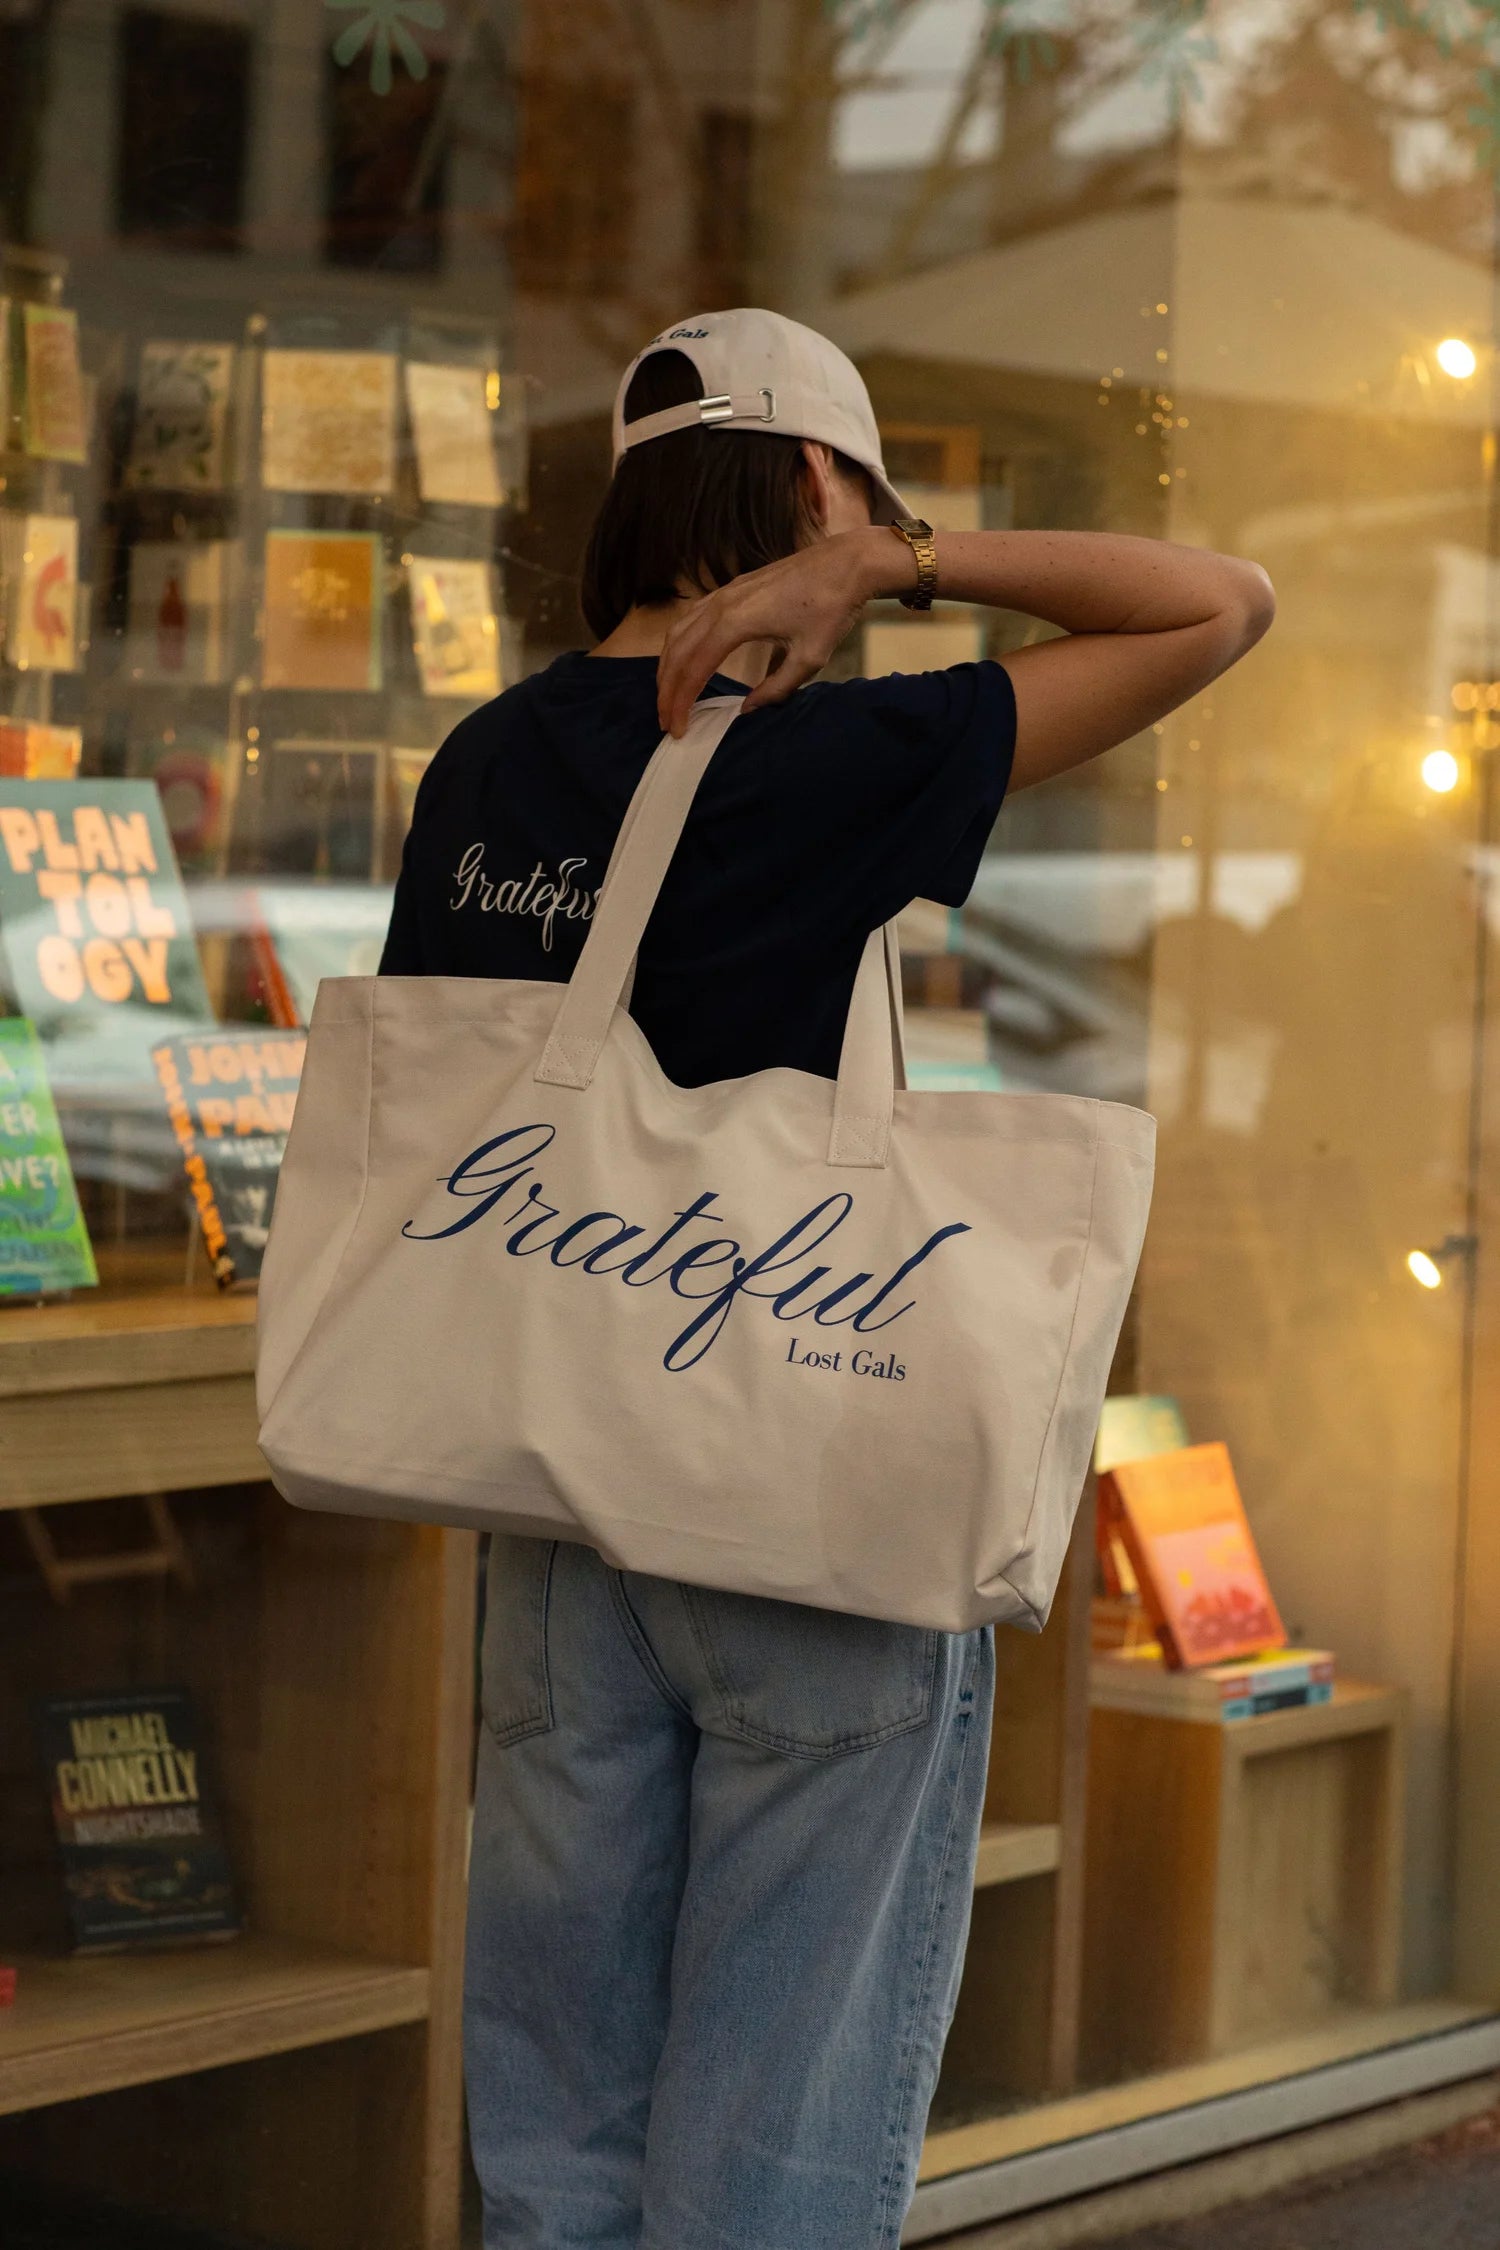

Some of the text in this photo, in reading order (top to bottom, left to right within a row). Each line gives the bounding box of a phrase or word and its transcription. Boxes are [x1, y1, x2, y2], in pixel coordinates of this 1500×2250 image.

[670, 329, 709, 340] Gals
[0, 806, 157, 874] PLAN
[38, 871, 176, 940] TOL
[37, 936, 172, 1003] OGY
[401, 1123, 972, 1373] Grateful
[785, 1337, 907, 1382] Lost Gals
[71, 1712, 175, 1757] MICHAEL
[57, 1748, 199, 1814] CONNELLY
